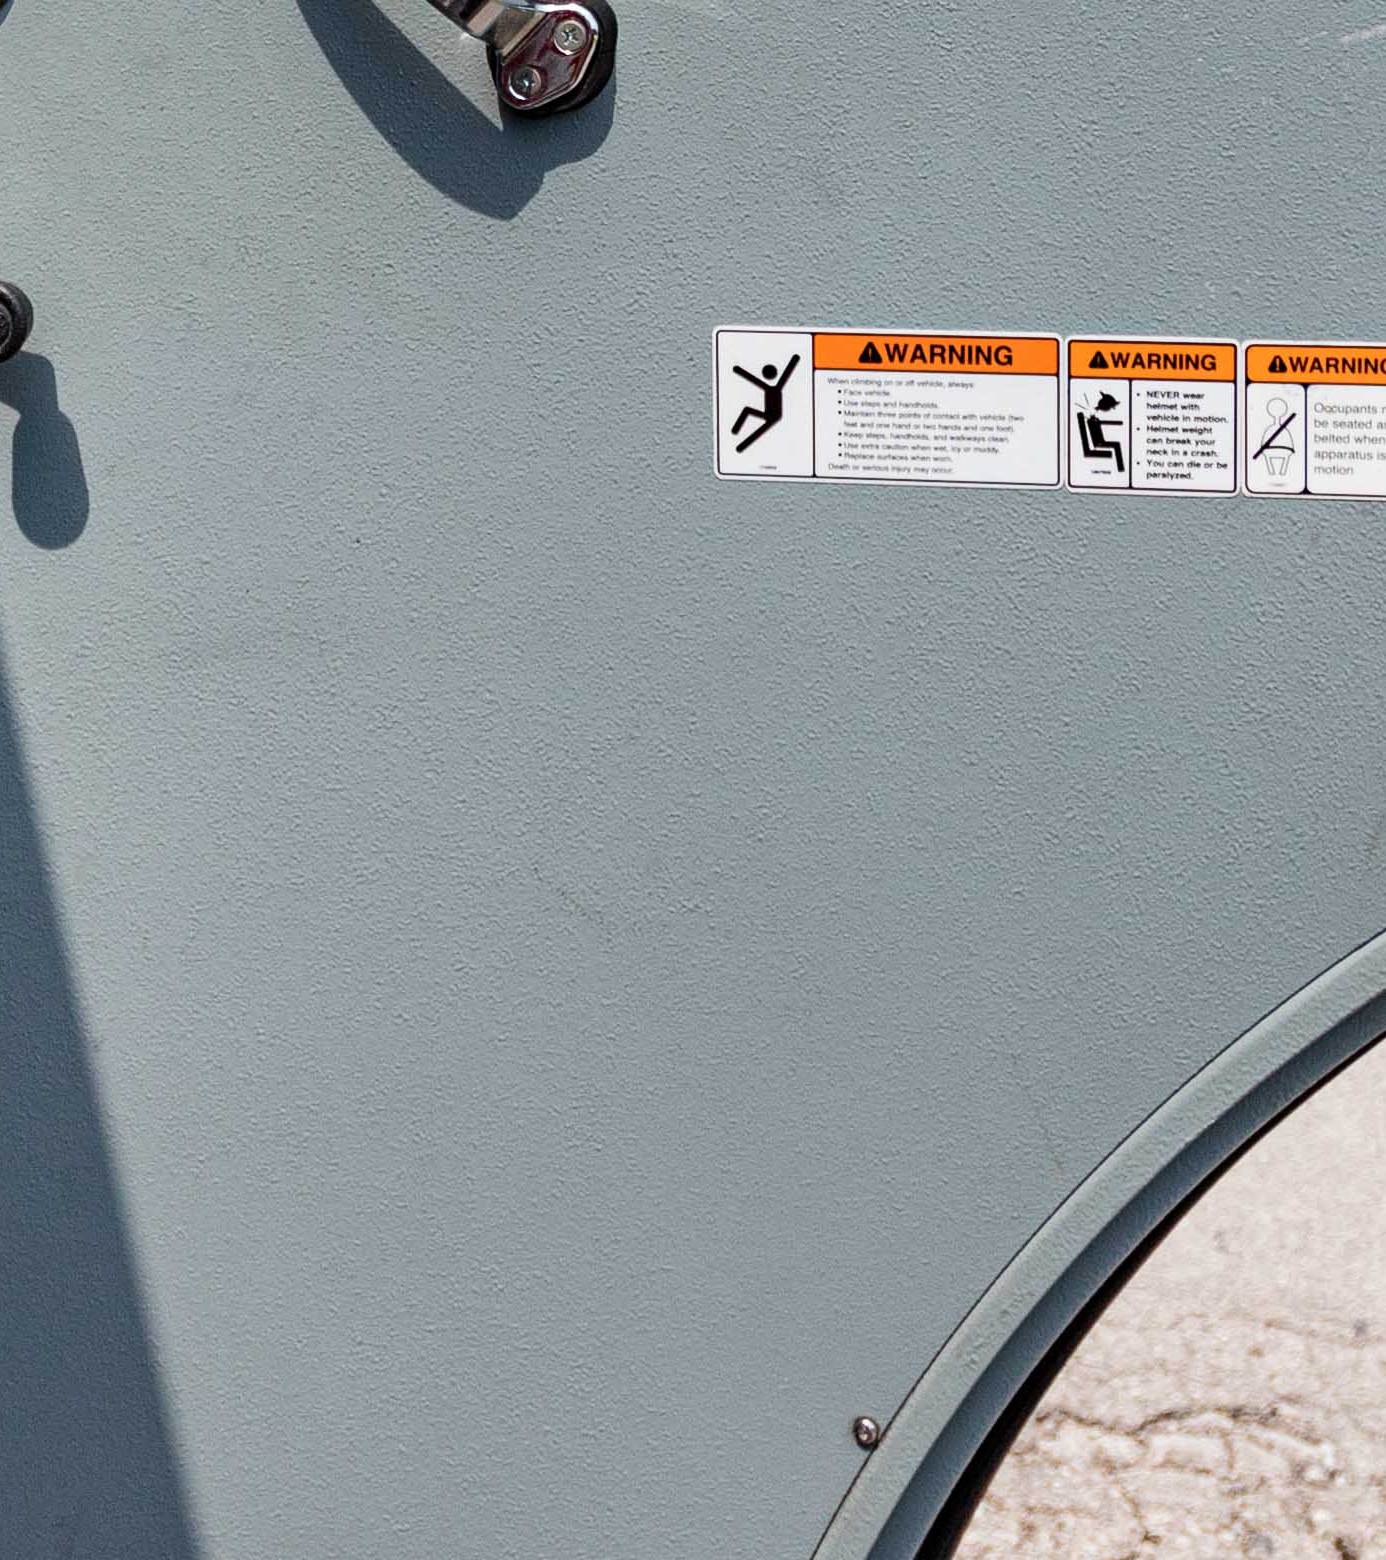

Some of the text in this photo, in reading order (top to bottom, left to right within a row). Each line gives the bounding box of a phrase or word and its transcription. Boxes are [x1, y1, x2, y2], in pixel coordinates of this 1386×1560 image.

[883, 343, 1014, 367] WARNING
[1111, 352, 1217, 372] WARNING
[1146, 402, 1177, 410] helmet
[1314, 402, 1378, 415] Occupants
[1194, 415, 1229, 423] motion.
[1314, 419, 1329, 428] be
[1333, 420, 1372, 429] seated
[1182, 427, 1212, 435] weight
[1195, 439, 1215, 447] your
[1314, 434, 1386, 445] belted when
[1314, 449, 1373, 461] apparatus
[1376, 450, 1386, 460] is
[1314, 465, 1354, 475] motion
